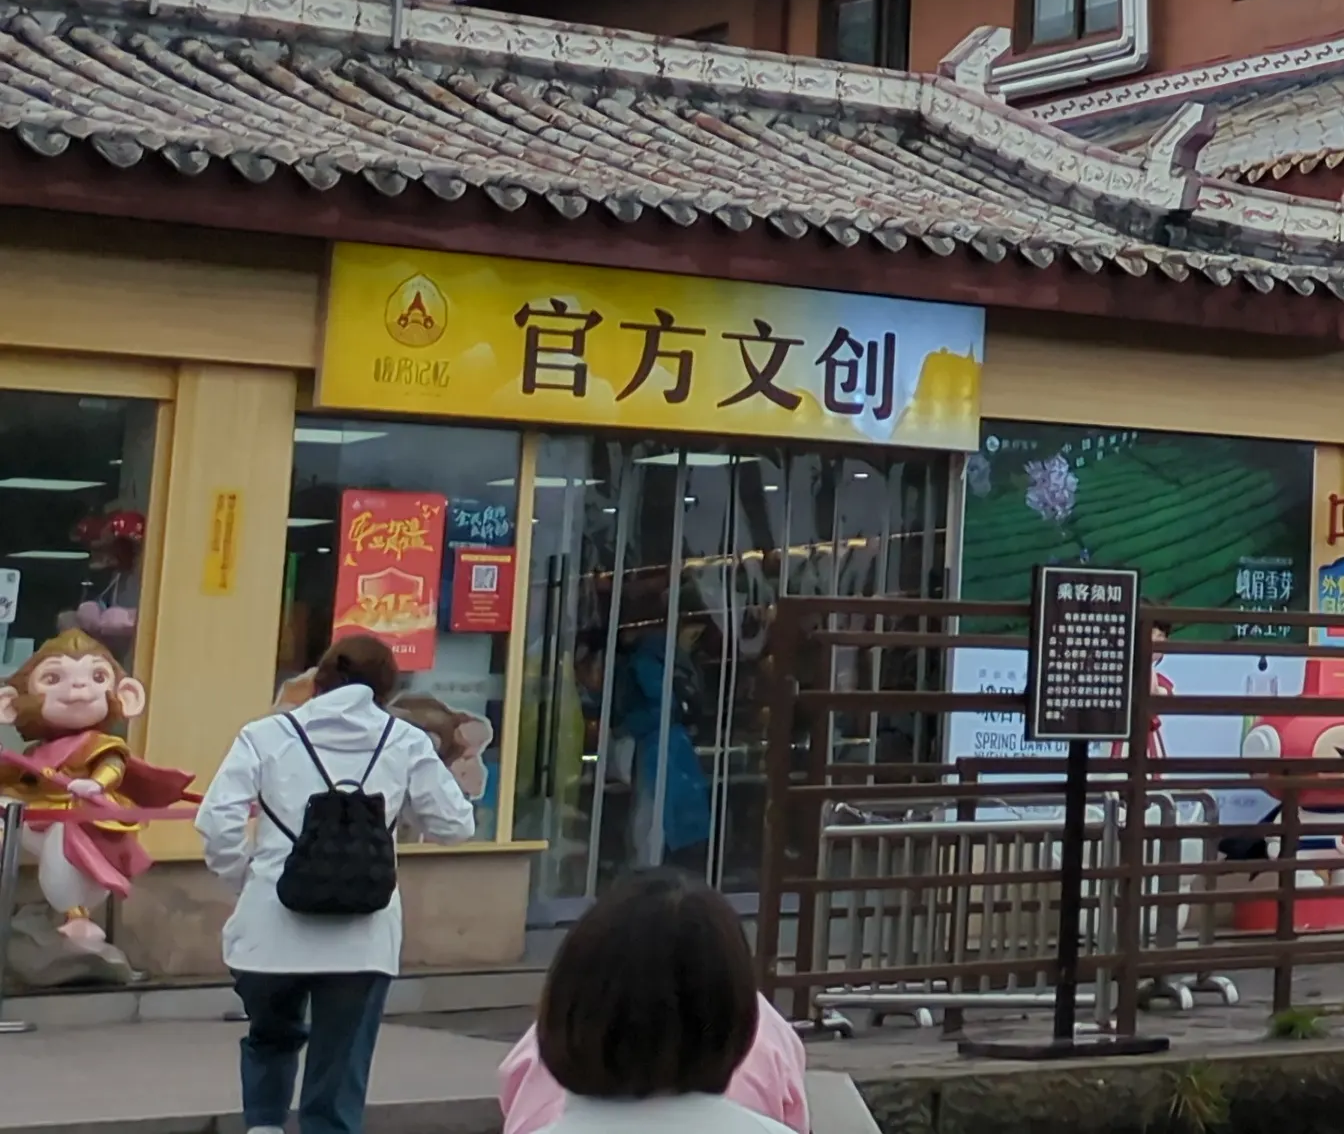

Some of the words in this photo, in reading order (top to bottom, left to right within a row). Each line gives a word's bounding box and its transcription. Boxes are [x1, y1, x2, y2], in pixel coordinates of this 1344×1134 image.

[514, 298, 897, 419] 官方文创
[1056, 582, 1123, 603] 乘客须知
[1235, 569, 1294, 601] 峨眉雪芽
[974, 731, 1017, 751] SPRING
